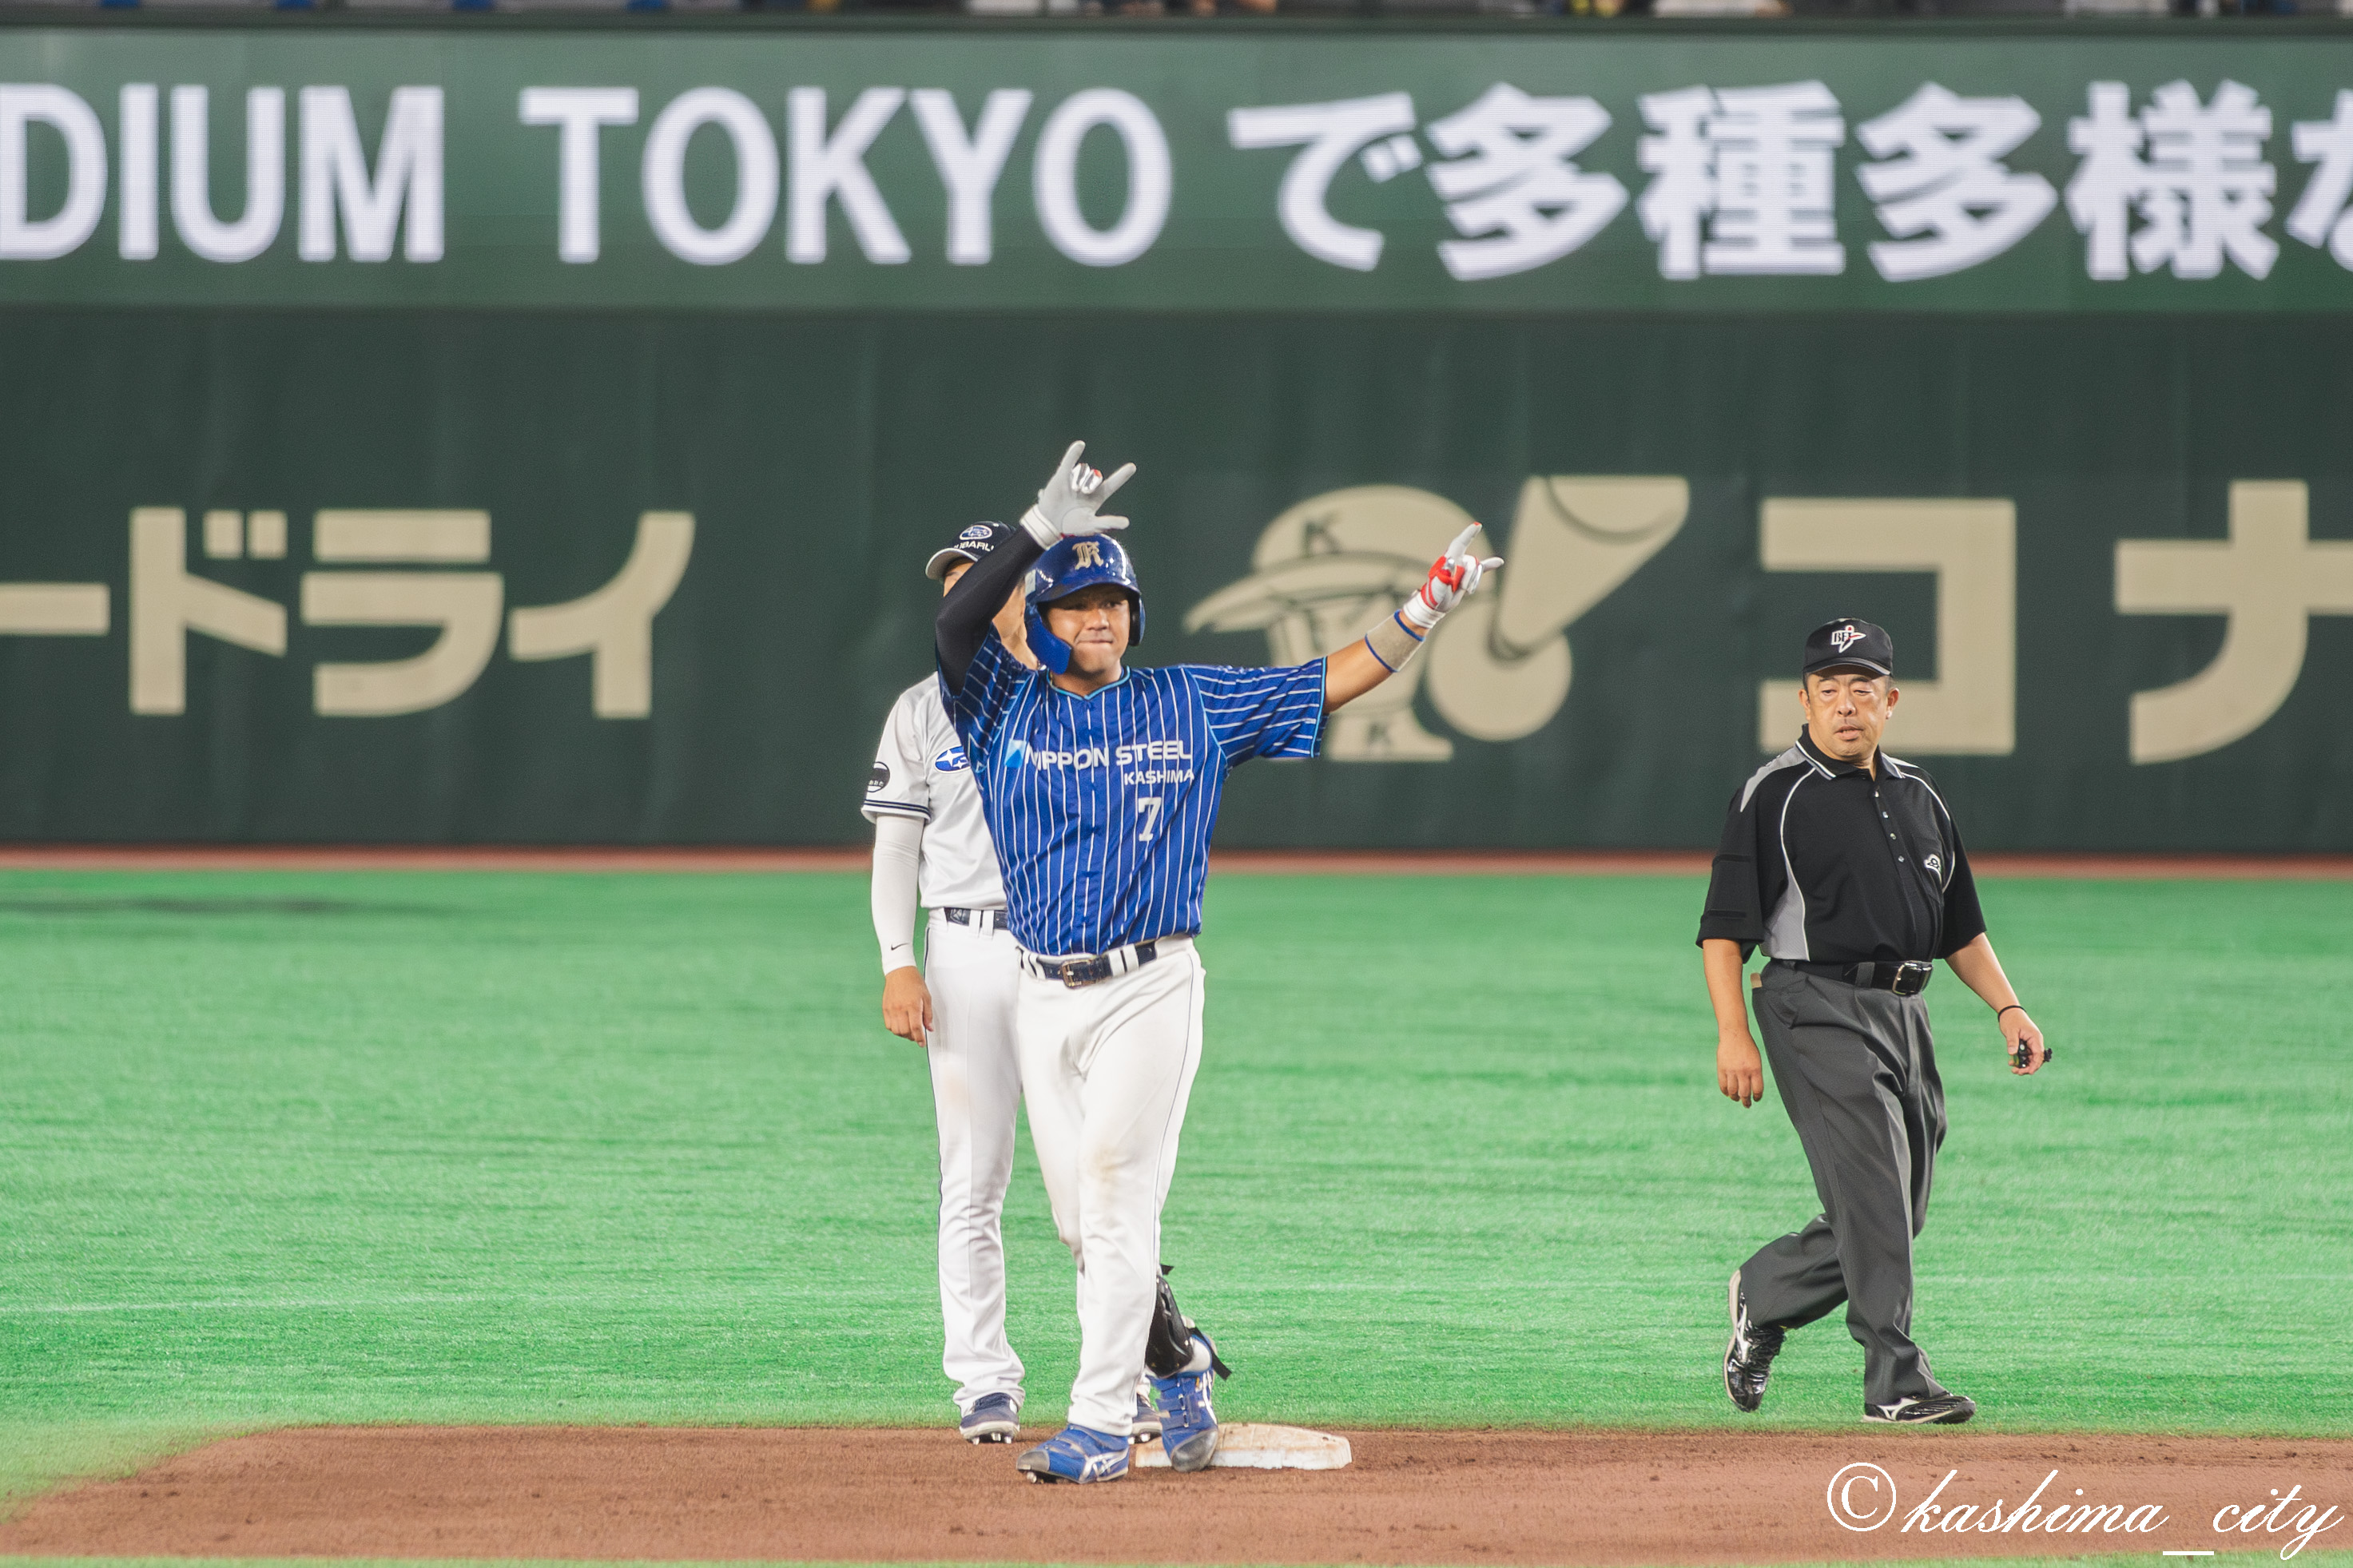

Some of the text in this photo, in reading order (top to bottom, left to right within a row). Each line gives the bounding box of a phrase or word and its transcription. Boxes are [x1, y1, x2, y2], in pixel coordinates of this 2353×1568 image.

[0, 83, 445, 263] DIUM
[518, 85, 1172, 267] TOKYO
[1025, 740, 1193, 772] NIPPON STEEL
[1124, 769, 1194, 786] KASHIMA
[1138, 796, 1162, 842] 7
